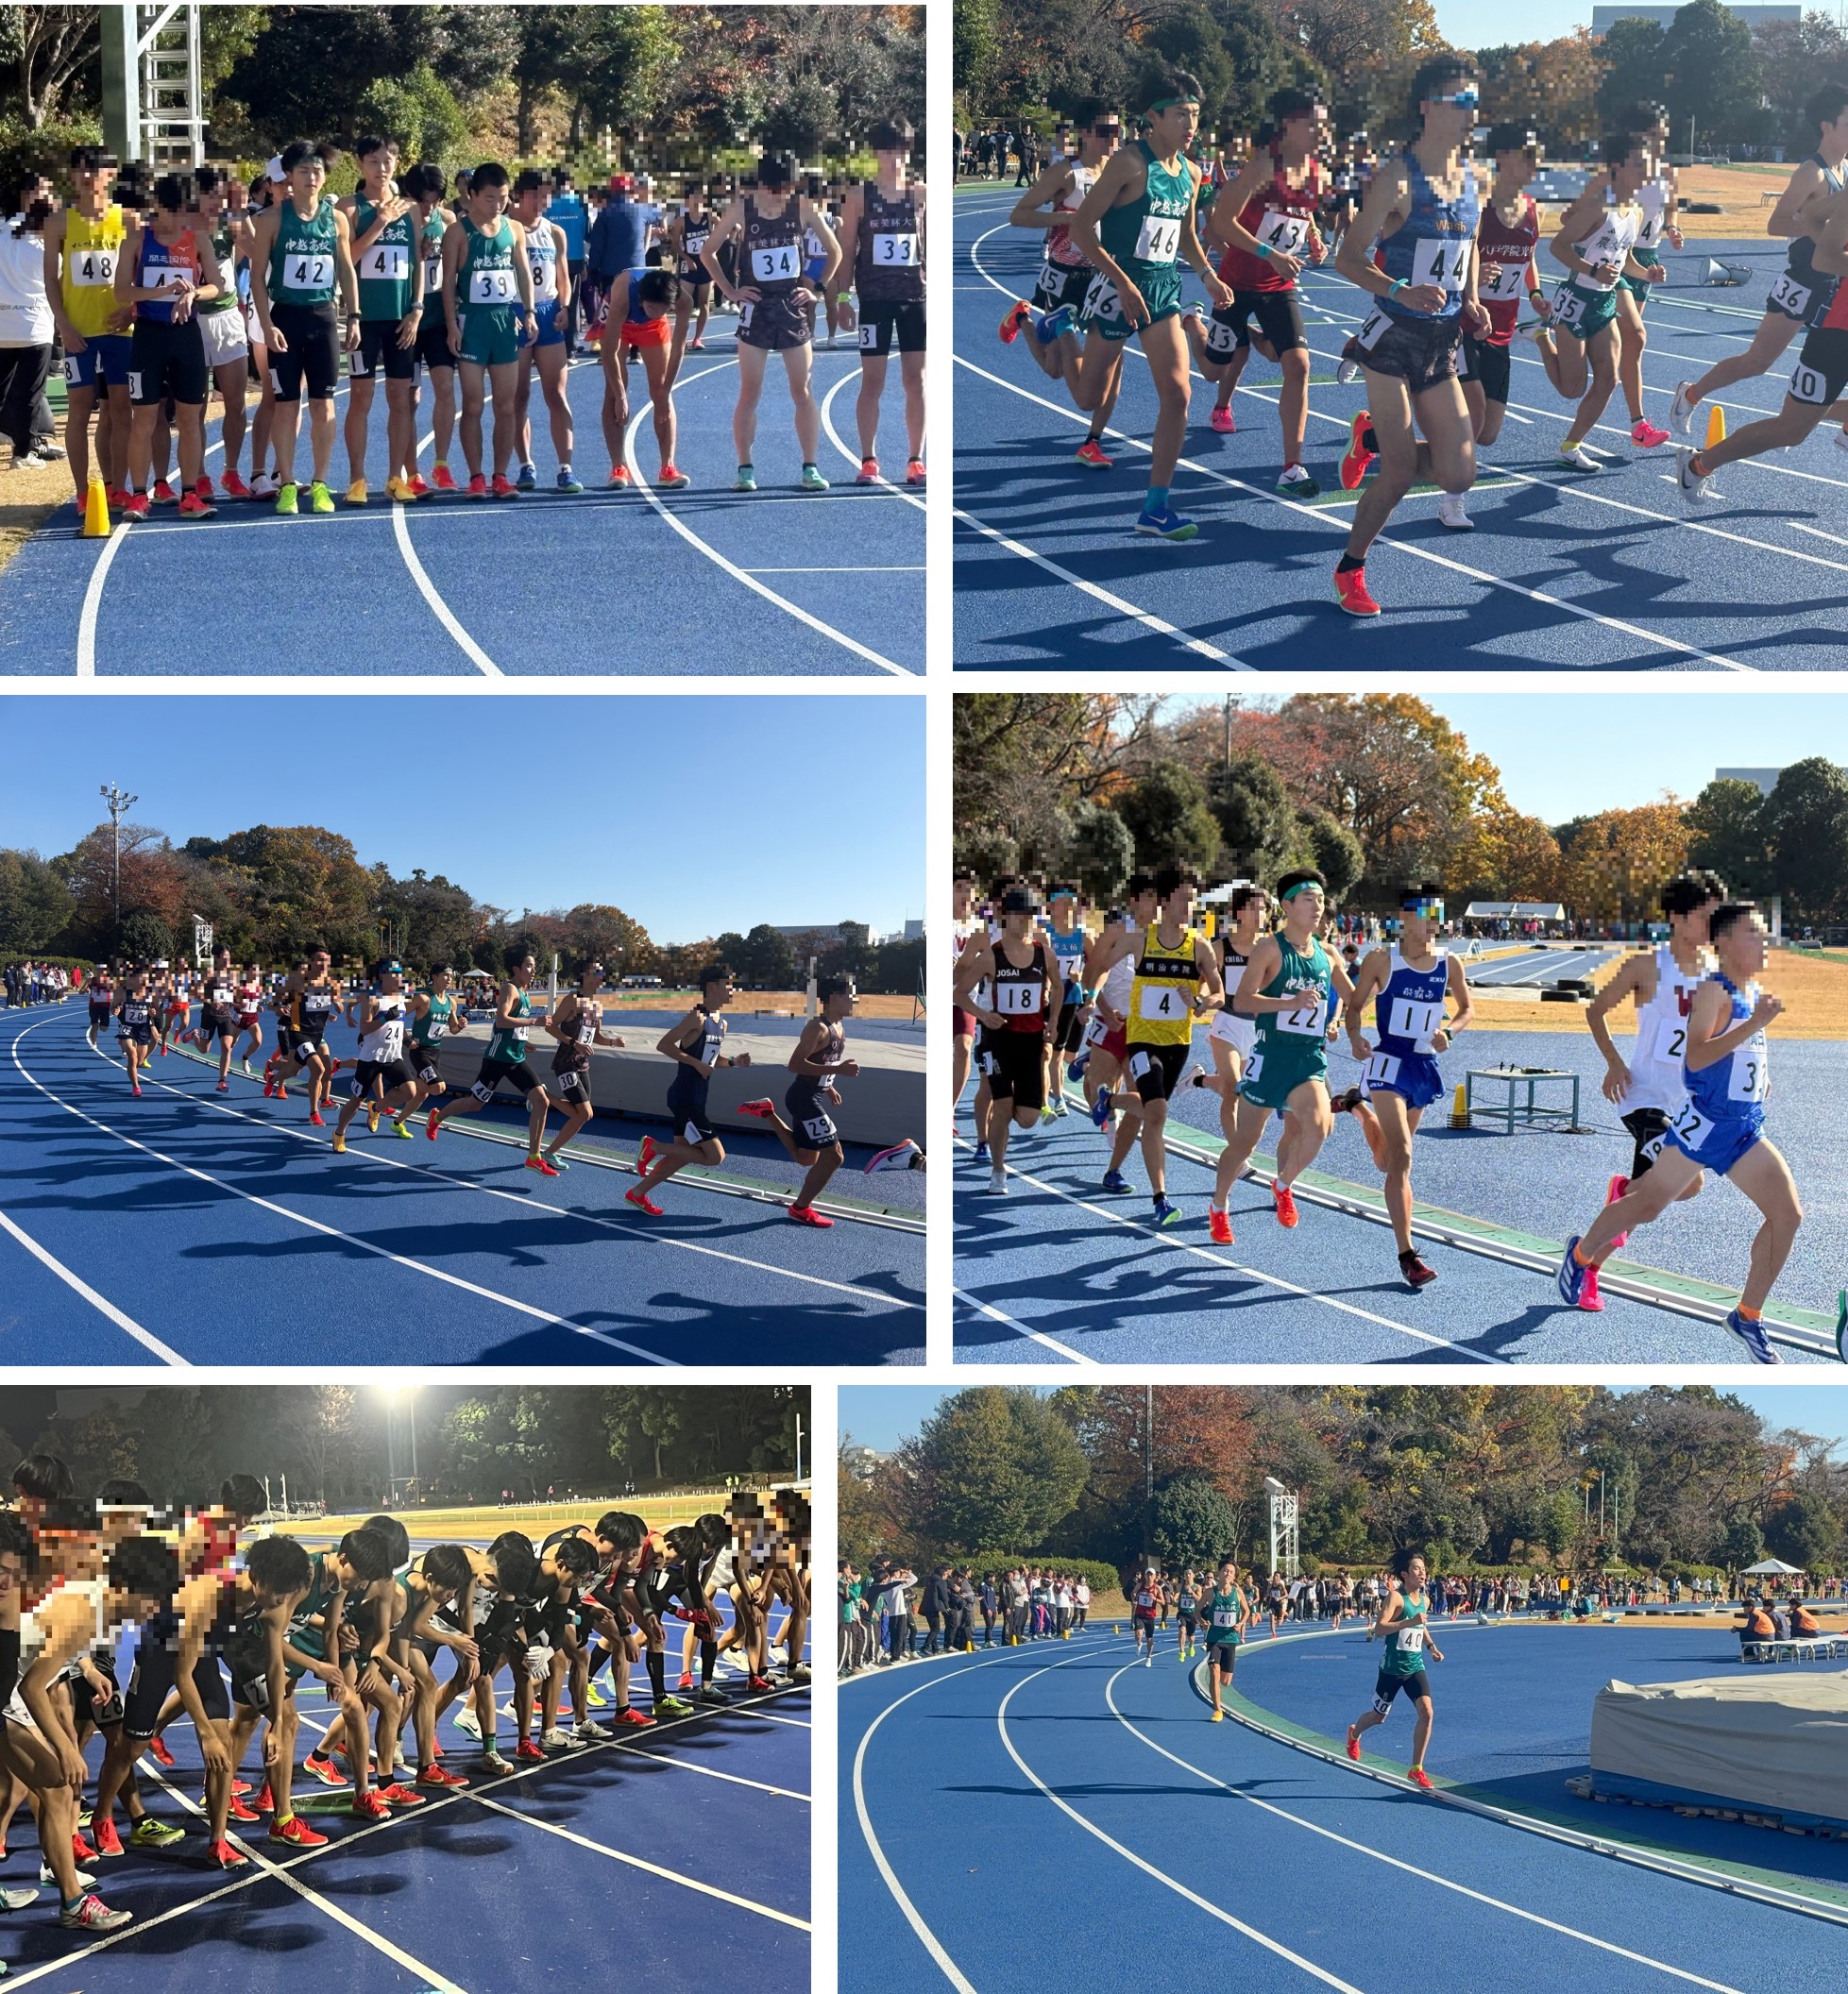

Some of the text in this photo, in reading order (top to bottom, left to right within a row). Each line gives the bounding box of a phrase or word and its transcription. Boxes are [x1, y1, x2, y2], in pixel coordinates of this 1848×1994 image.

[870, 218, 916, 228] 桜美林大
[1149, 227, 1176, 254] 46
[1268, 223, 1299, 249] 43
[883, 240, 911, 261] 33
[82, 257, 112, 279] 48
[295, 262, 324, 283] 42
[374, 251, 398, 273] 41
[762, 252, 790, 275] 34
[1430, 249, 1465, 281] 44
[533, 266, 543, 286] 8
[1042, 267, 1059, 290] 45
[1488, 270, 1521, 294] 42
[481, 277, 507, 297] 39
[1776, 279, 1803, 308] 36
[1088, 284, 1118, 314] 46
[1554, 294, 1579, 319] 35
[739, 306, 747, 323] 4
[1209, 324, 1229, 348] 43
[65, 361, 74, 380] 8
[1791, 365, 1815, 397] 40
[996, 969, 1020, 978] JOSAI
[1145, 962, 1191, 974] 明治学院
[1009, 989, 1031, 1009] 18
[1159, 993, 1171, 1015] 4
[129, 1012, 144, 1022] 20
[1405, 1006, 1432, 1032] 11
[385, 1026, 399, 1040] 24
[303, 1045, 309, 1054] 6
[1245, 1056, 1256, 1077] 2
[561, 1073, 574, 1090] 30
[476, 1086, 492, 1101] 40
[808, 1118, 831, 1137] 29
[1673, 1103, 1702, 1142] 32
[1219, 1614, 1231, 1625] 41
[1405, 1631, 1422, 1648] 40
[1375, 1698, 1388, 1714] 40
